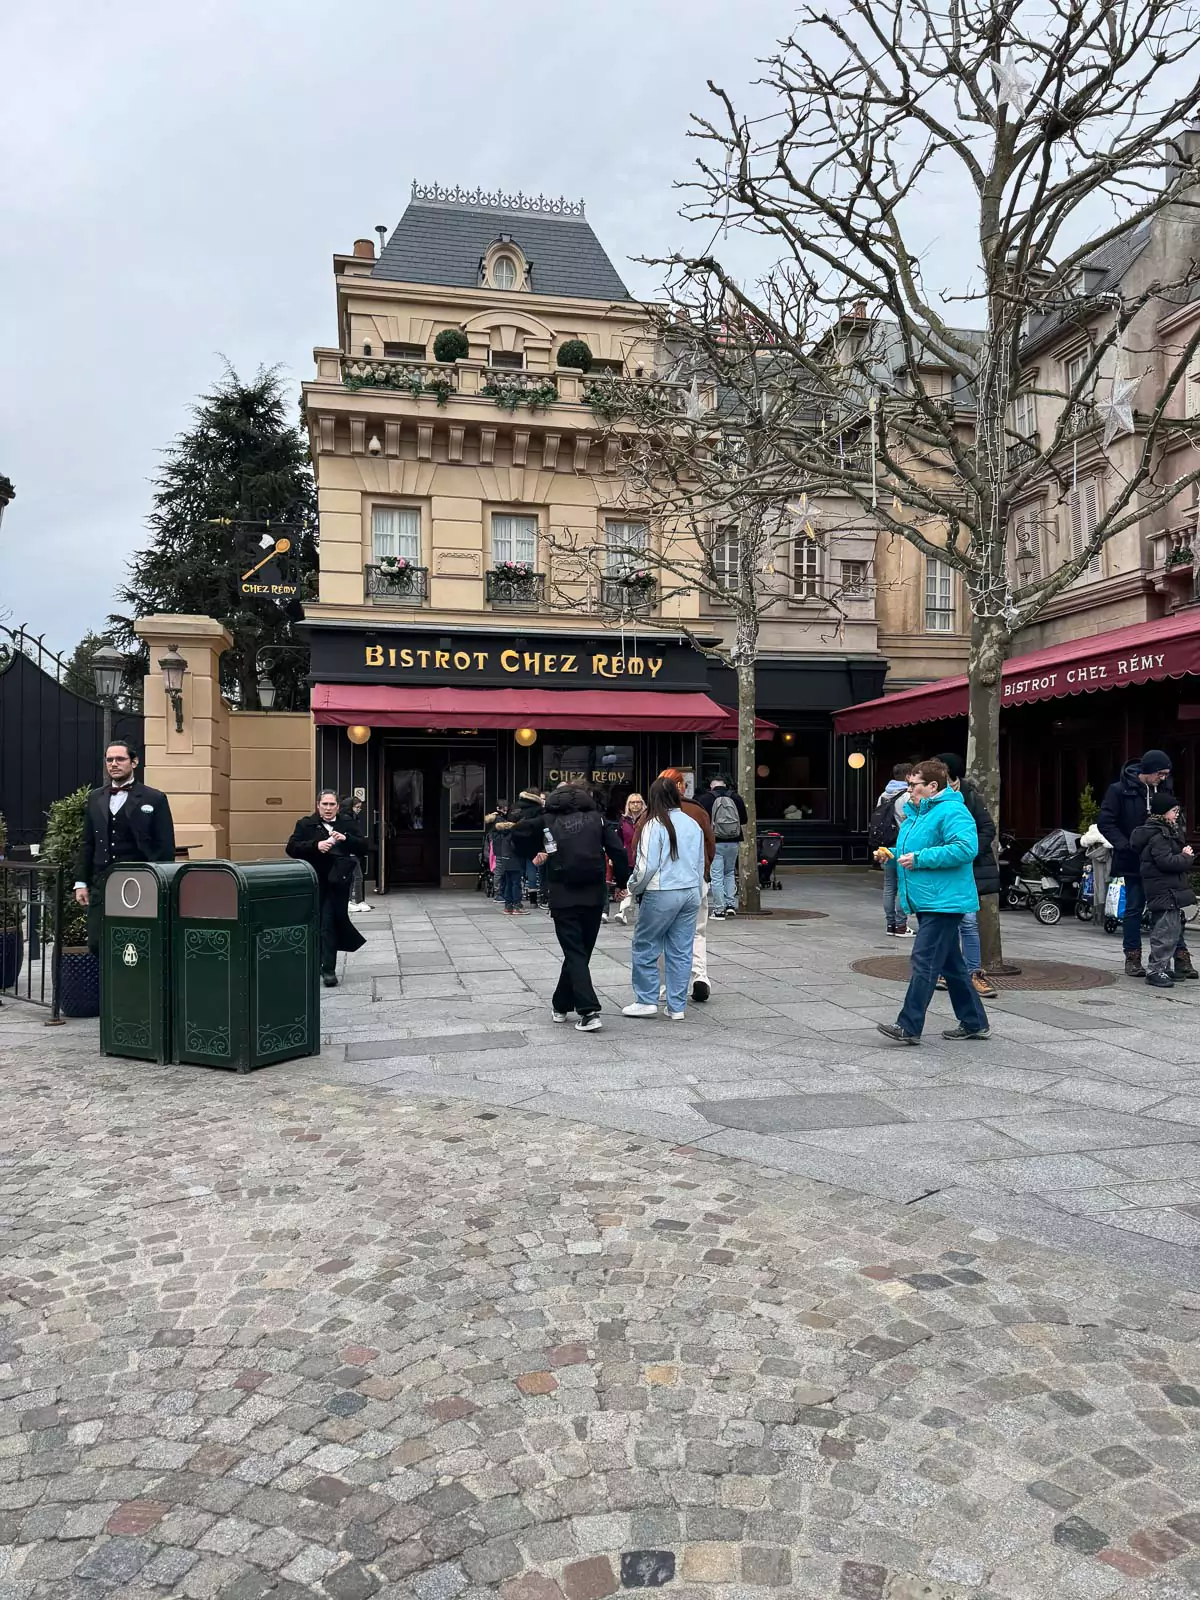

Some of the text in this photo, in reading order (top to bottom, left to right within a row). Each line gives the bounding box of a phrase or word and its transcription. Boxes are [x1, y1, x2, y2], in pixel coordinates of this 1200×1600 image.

[242, 583, 296, 594] CHEZ RÉMY
[365, 645, 663, 678] BISTROT CHEZ RÉMY
[1003, 653, 1165, 696] BISTROT CHEZ RÉMY
[549, 769, 585, 782] CHEZ
